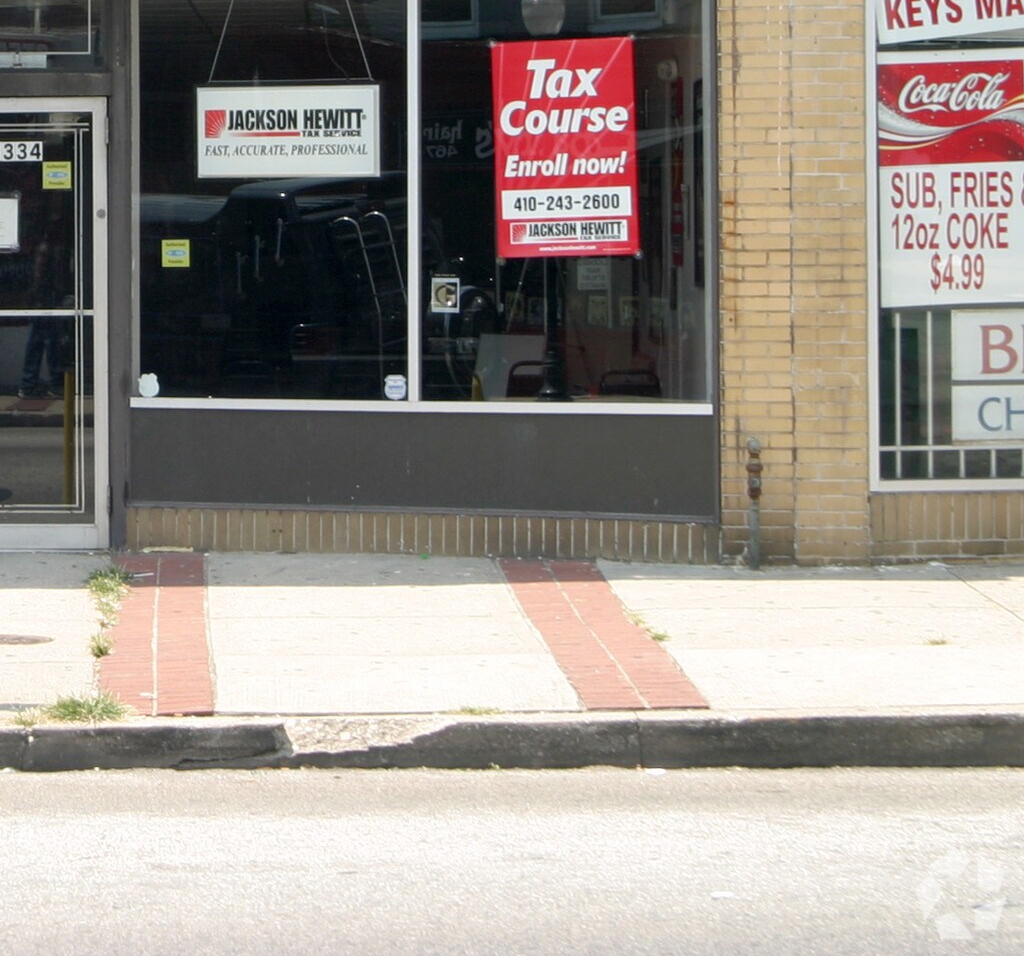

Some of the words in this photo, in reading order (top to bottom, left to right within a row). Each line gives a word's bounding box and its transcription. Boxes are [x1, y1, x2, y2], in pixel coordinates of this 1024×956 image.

[526, 58, 603, 100] Tax
[898, 71, 1012, 114] Coca-Cola
[227, 109, 297, 131] JACKSON
[303, 108, 363, 129] HEWITT
[301, 130, 320, 138] TAX
[499, 100, 629, 136] Course
[204, 145, 231, 157] FAST,
[233, 144, 289, 157] ACCURATE,
[290, 144, 368, 156] PROFESSIONAL
[504, 153, 569, 179] Enroll
[571, 150, 628, 176] now!
[513, 193, 621, 212] 410-243-2600
[890, 171, 943, 214] SUB,
[950, 171, 1013, 208] FRIES
[528, 223, 577, 238] JACKSON
[580, 221, 623, 237] HEWITT
[890, 213, 940, 250] 12oz
[946, 212, 1009, 250] COKE
[929, 250, 985, 294] $4.99
[979, 324, 1024, 375] B
